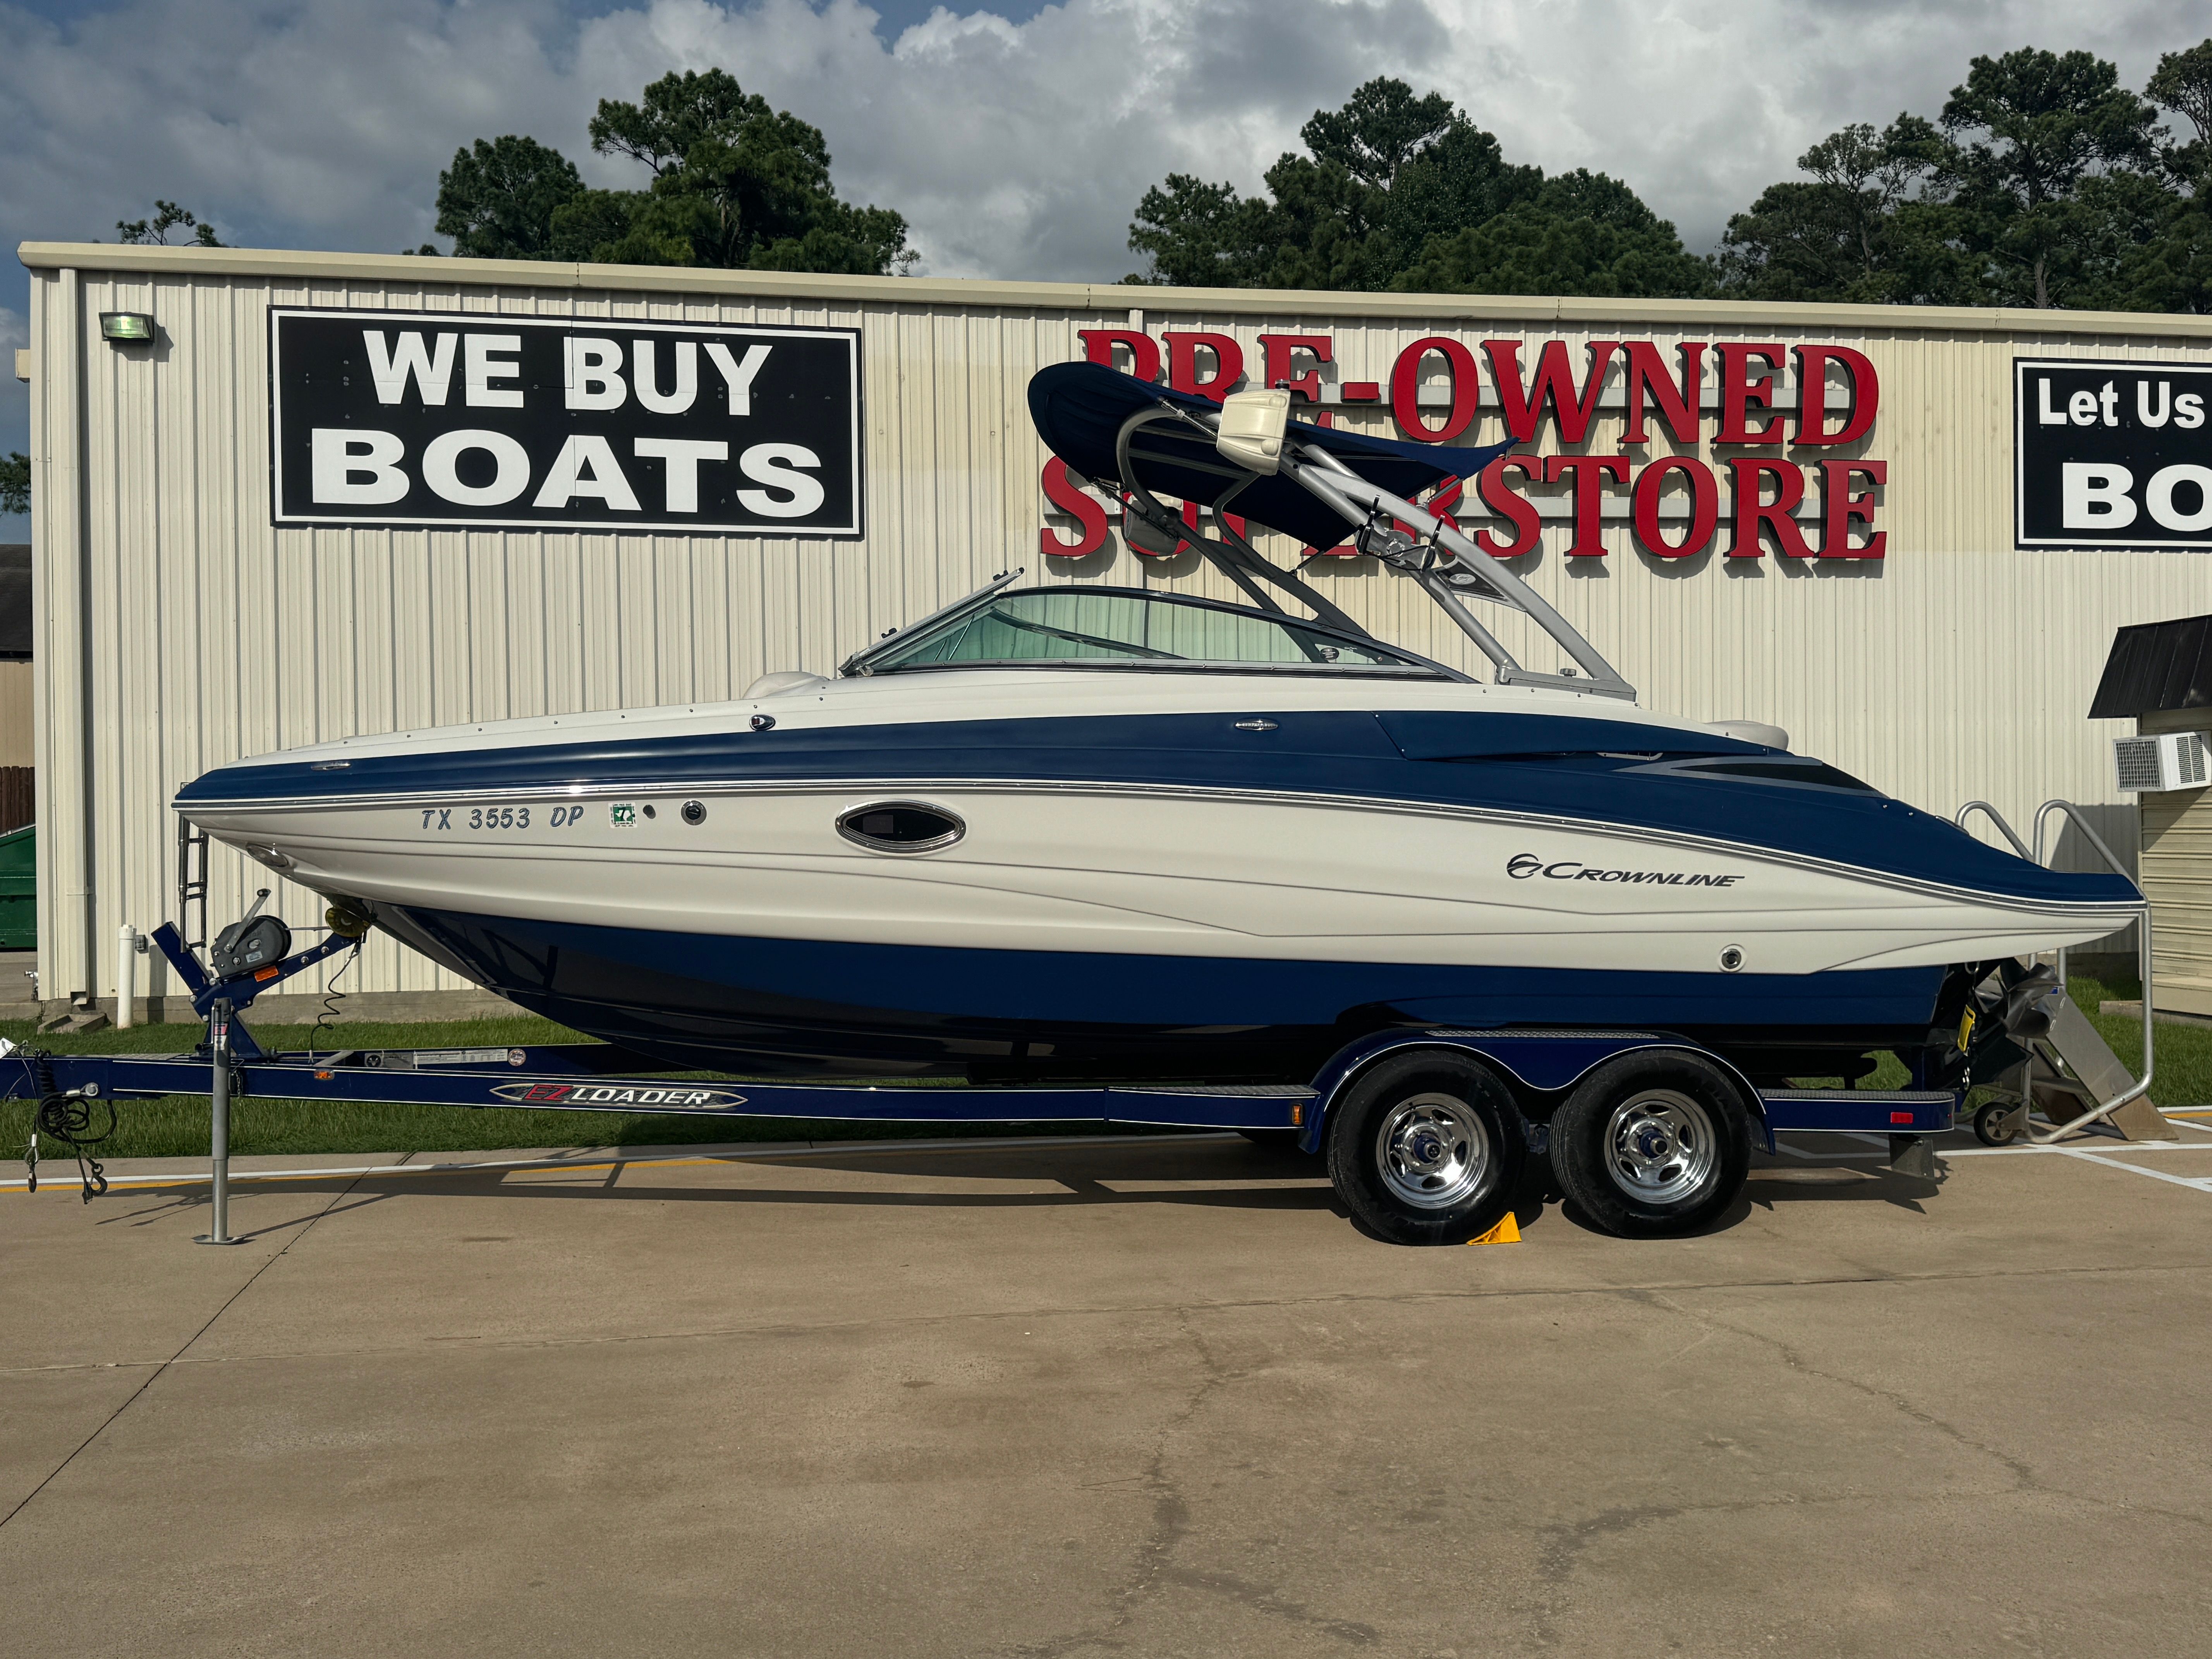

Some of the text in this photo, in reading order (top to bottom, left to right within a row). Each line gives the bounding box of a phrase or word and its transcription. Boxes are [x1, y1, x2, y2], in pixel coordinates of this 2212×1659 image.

[362, 330, 773, 416] WE BUY
[2039, 378, 2205, 429] Let Us
[311, 428, 825, 518] BOATS
[2062, 462, 2212, 531] BO
[422, 805, 584, 830] TX 3553 DP
[524, 1084, 711, 1105] EZ LOADER
